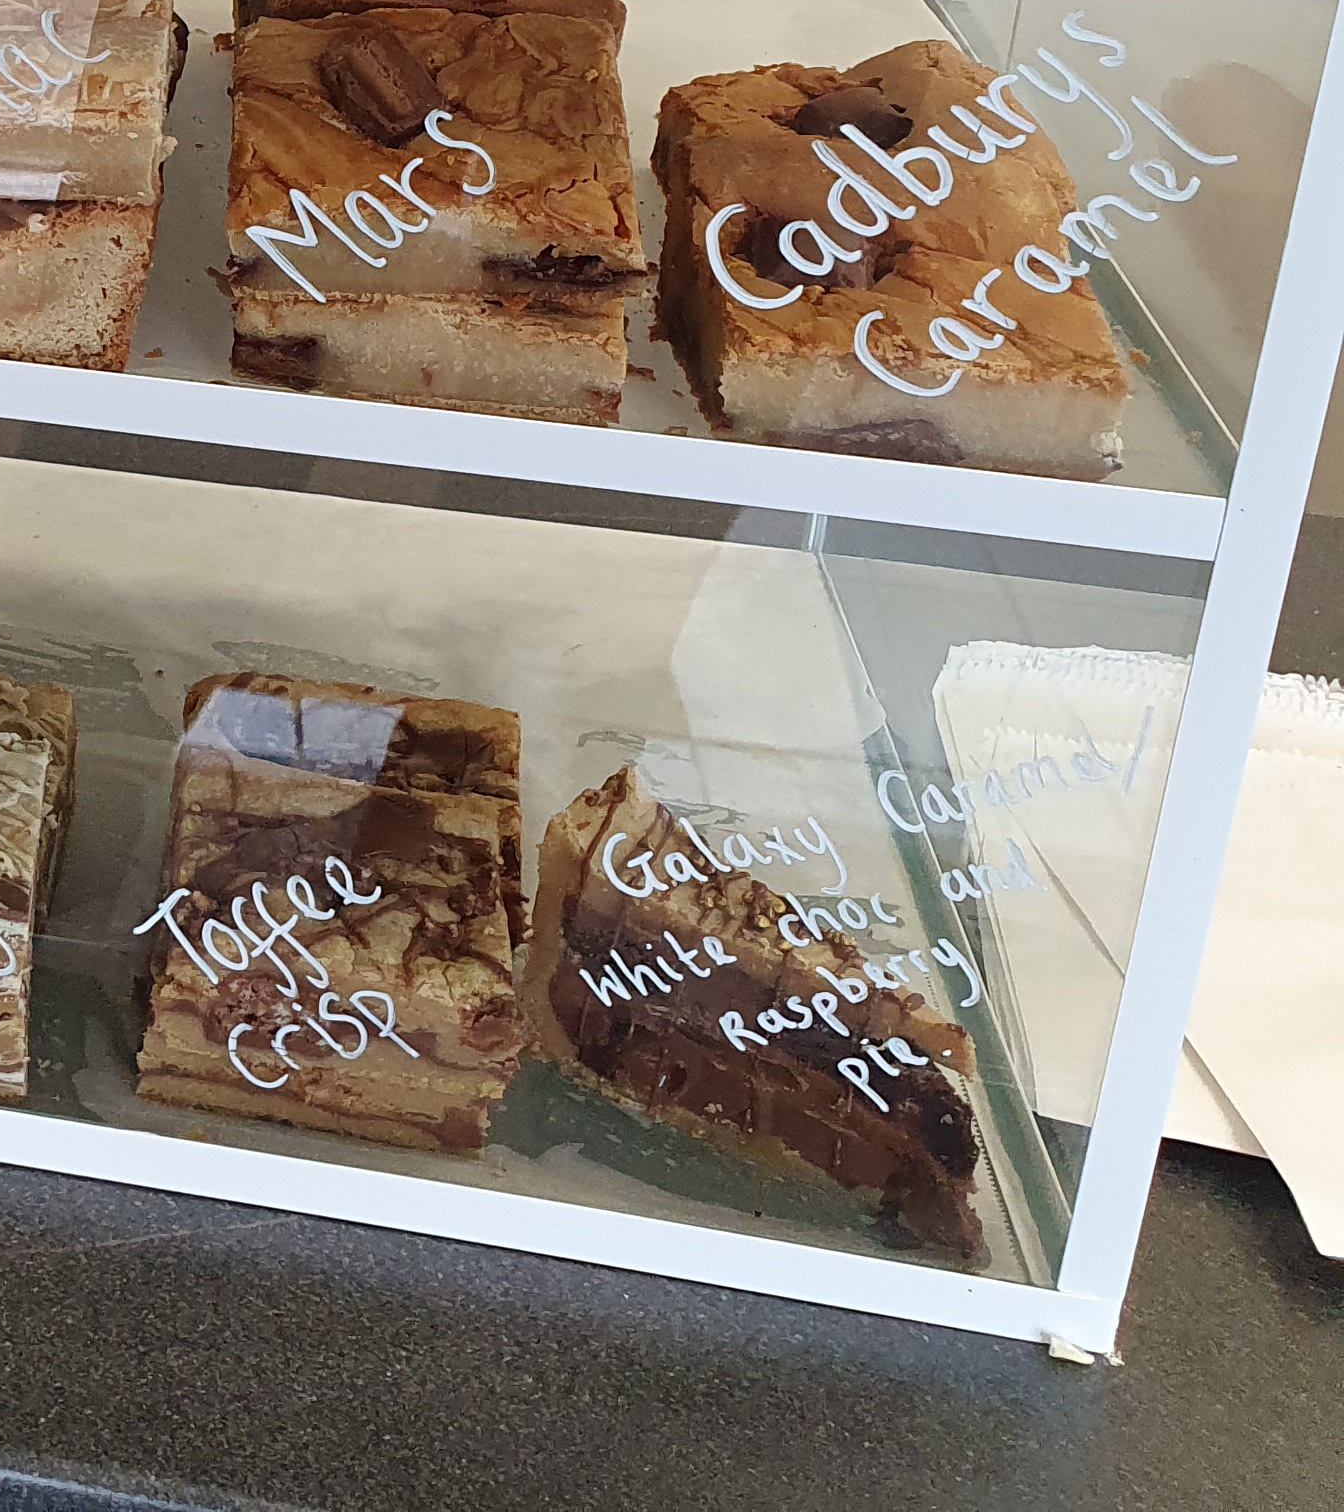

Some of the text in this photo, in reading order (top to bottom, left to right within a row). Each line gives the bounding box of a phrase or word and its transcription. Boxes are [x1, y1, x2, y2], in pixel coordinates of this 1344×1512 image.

[245, 109, 497, 304] Mars
[705, 9, 1132, 311] Cadburys
[854, 95, 1237, 397] Caramel
[133, 855, 382, 997] Toffee
[579, 929, 737, 1008] White
[940, 837, 1048, 901] and
[601, 816, 847, 898] Galaxy
[719, 936, 983, 1052] Raspberry
